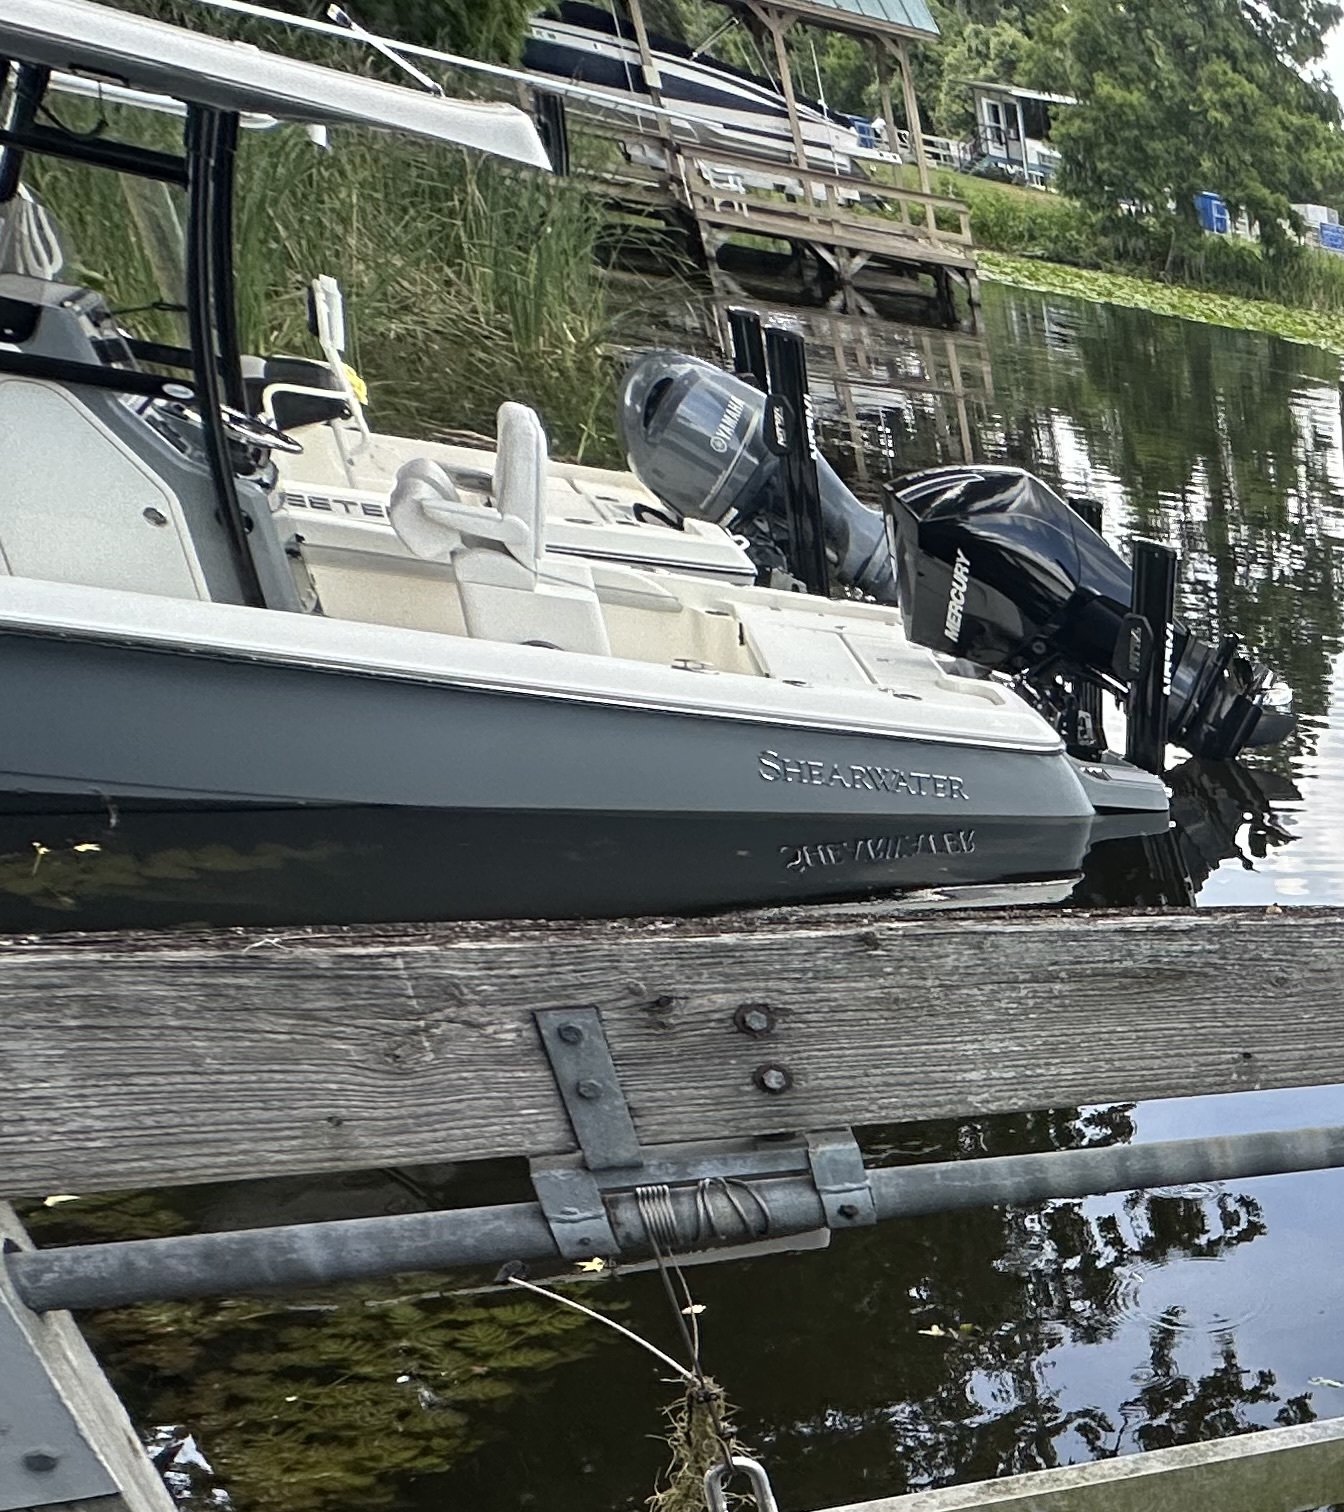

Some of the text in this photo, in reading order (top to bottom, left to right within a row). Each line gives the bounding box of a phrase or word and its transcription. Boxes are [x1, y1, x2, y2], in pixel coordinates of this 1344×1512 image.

[715, 395, 746, 441] YAMAHA
[944, 548, 971, 643] MERCURY
[758, 750, 970, 800] SHEARWATER
